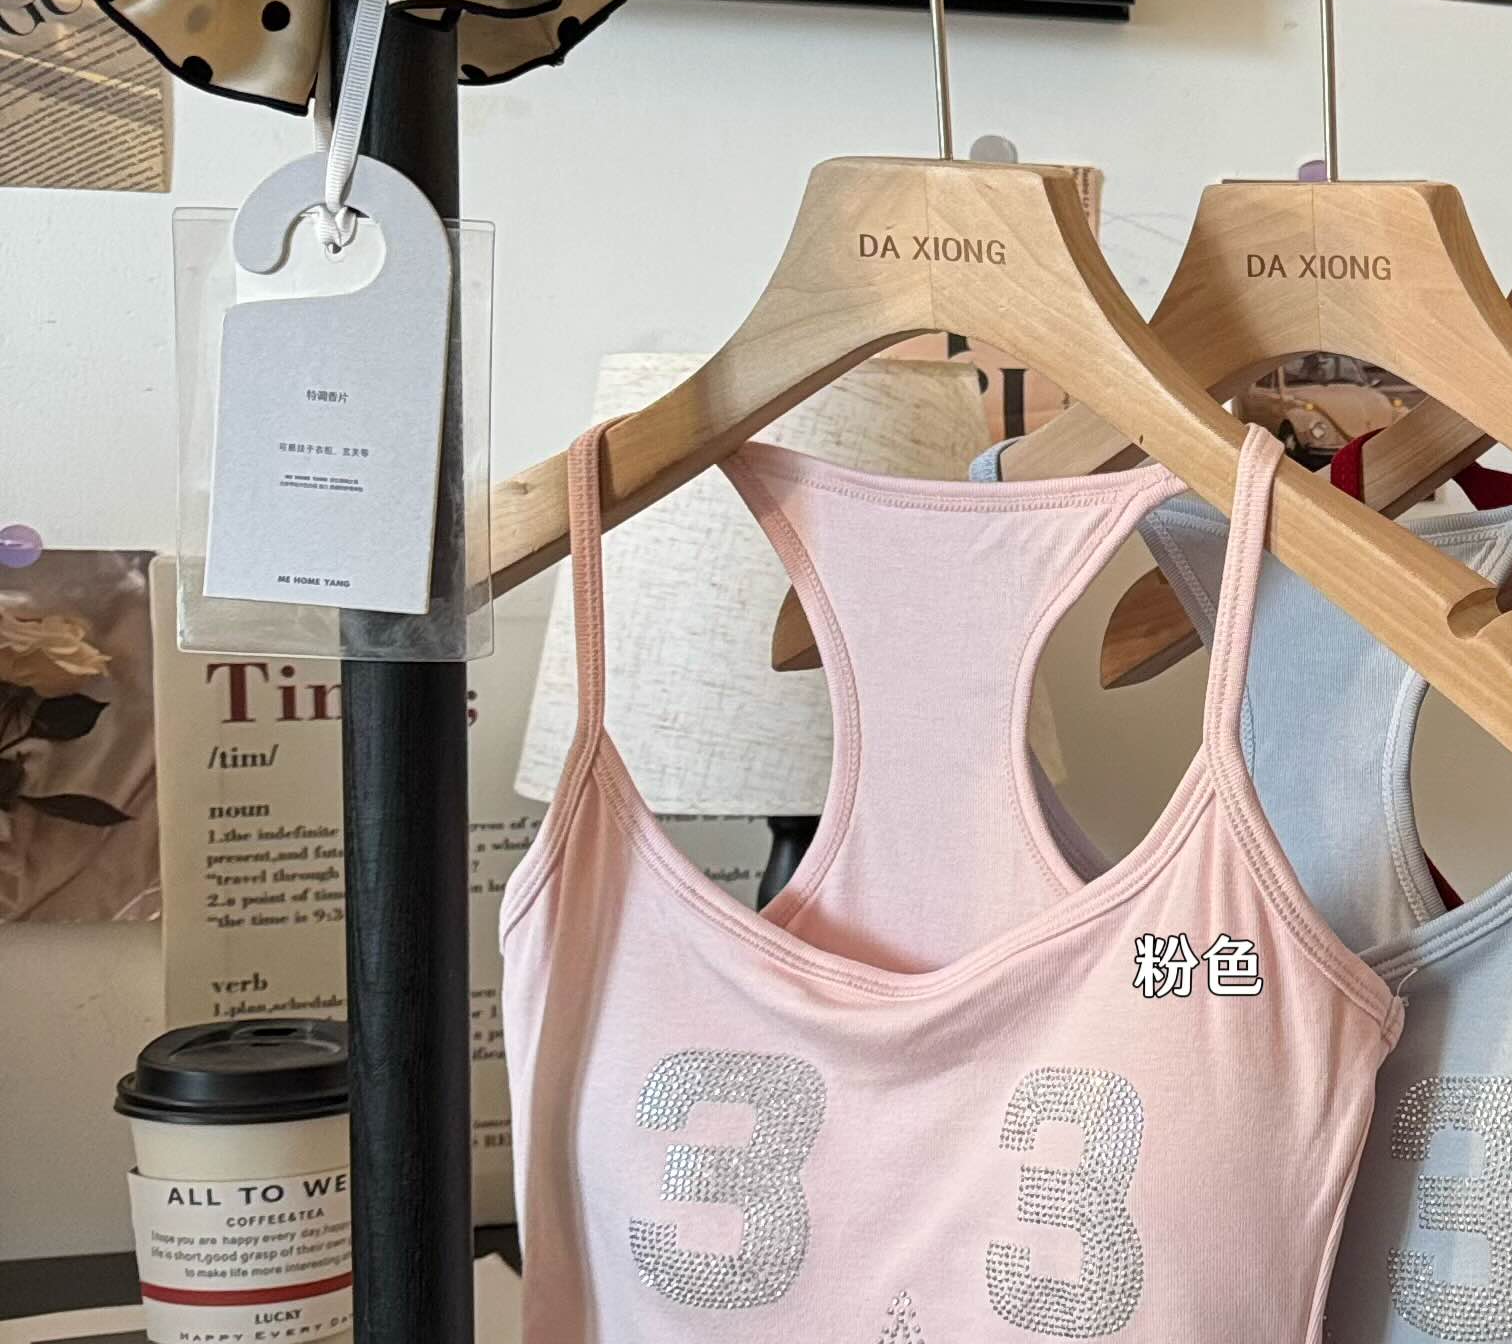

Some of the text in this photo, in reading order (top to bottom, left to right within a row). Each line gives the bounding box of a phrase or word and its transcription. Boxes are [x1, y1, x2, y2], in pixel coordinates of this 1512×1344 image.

[859, 233, 1008, 266] DA XIONG
[1246, 254, 1393, 281] DA XIONG
[277, 575, 351, 588] ME HOME YANG
[208, 804, 270, 820] noun
[272, 865, 340, 882] through
[211, 972, 269, 993] verb
[167, 1187, 221, 1206] ALL
[238, 1185, 285, 1204] TO
[628, 1047, 1145, 1340] 3 3
[226, 1207, 325, 1228] COFFEE&TEA
[177, 1236, 195, 1247] you
[199, 1236, 217, 1245] are
[222, 1233, 260, 1247] happy
[262, 1231, 297, 1245] every
[241, 1250, 278, 1264] grasp
[279, 1246, 295, 1259] of
[296, 1242, 324, 1256] their
[197, 1267, 227, 1278] make
[230, 1266, 248, 1278] life
[251, 1265, 282, 1277] more
[255, 1308, 302, 1325] LUCKY
[179, 1332, 244, 1342] HAPPY
[254, 1323, 322, 1341] EVERY
